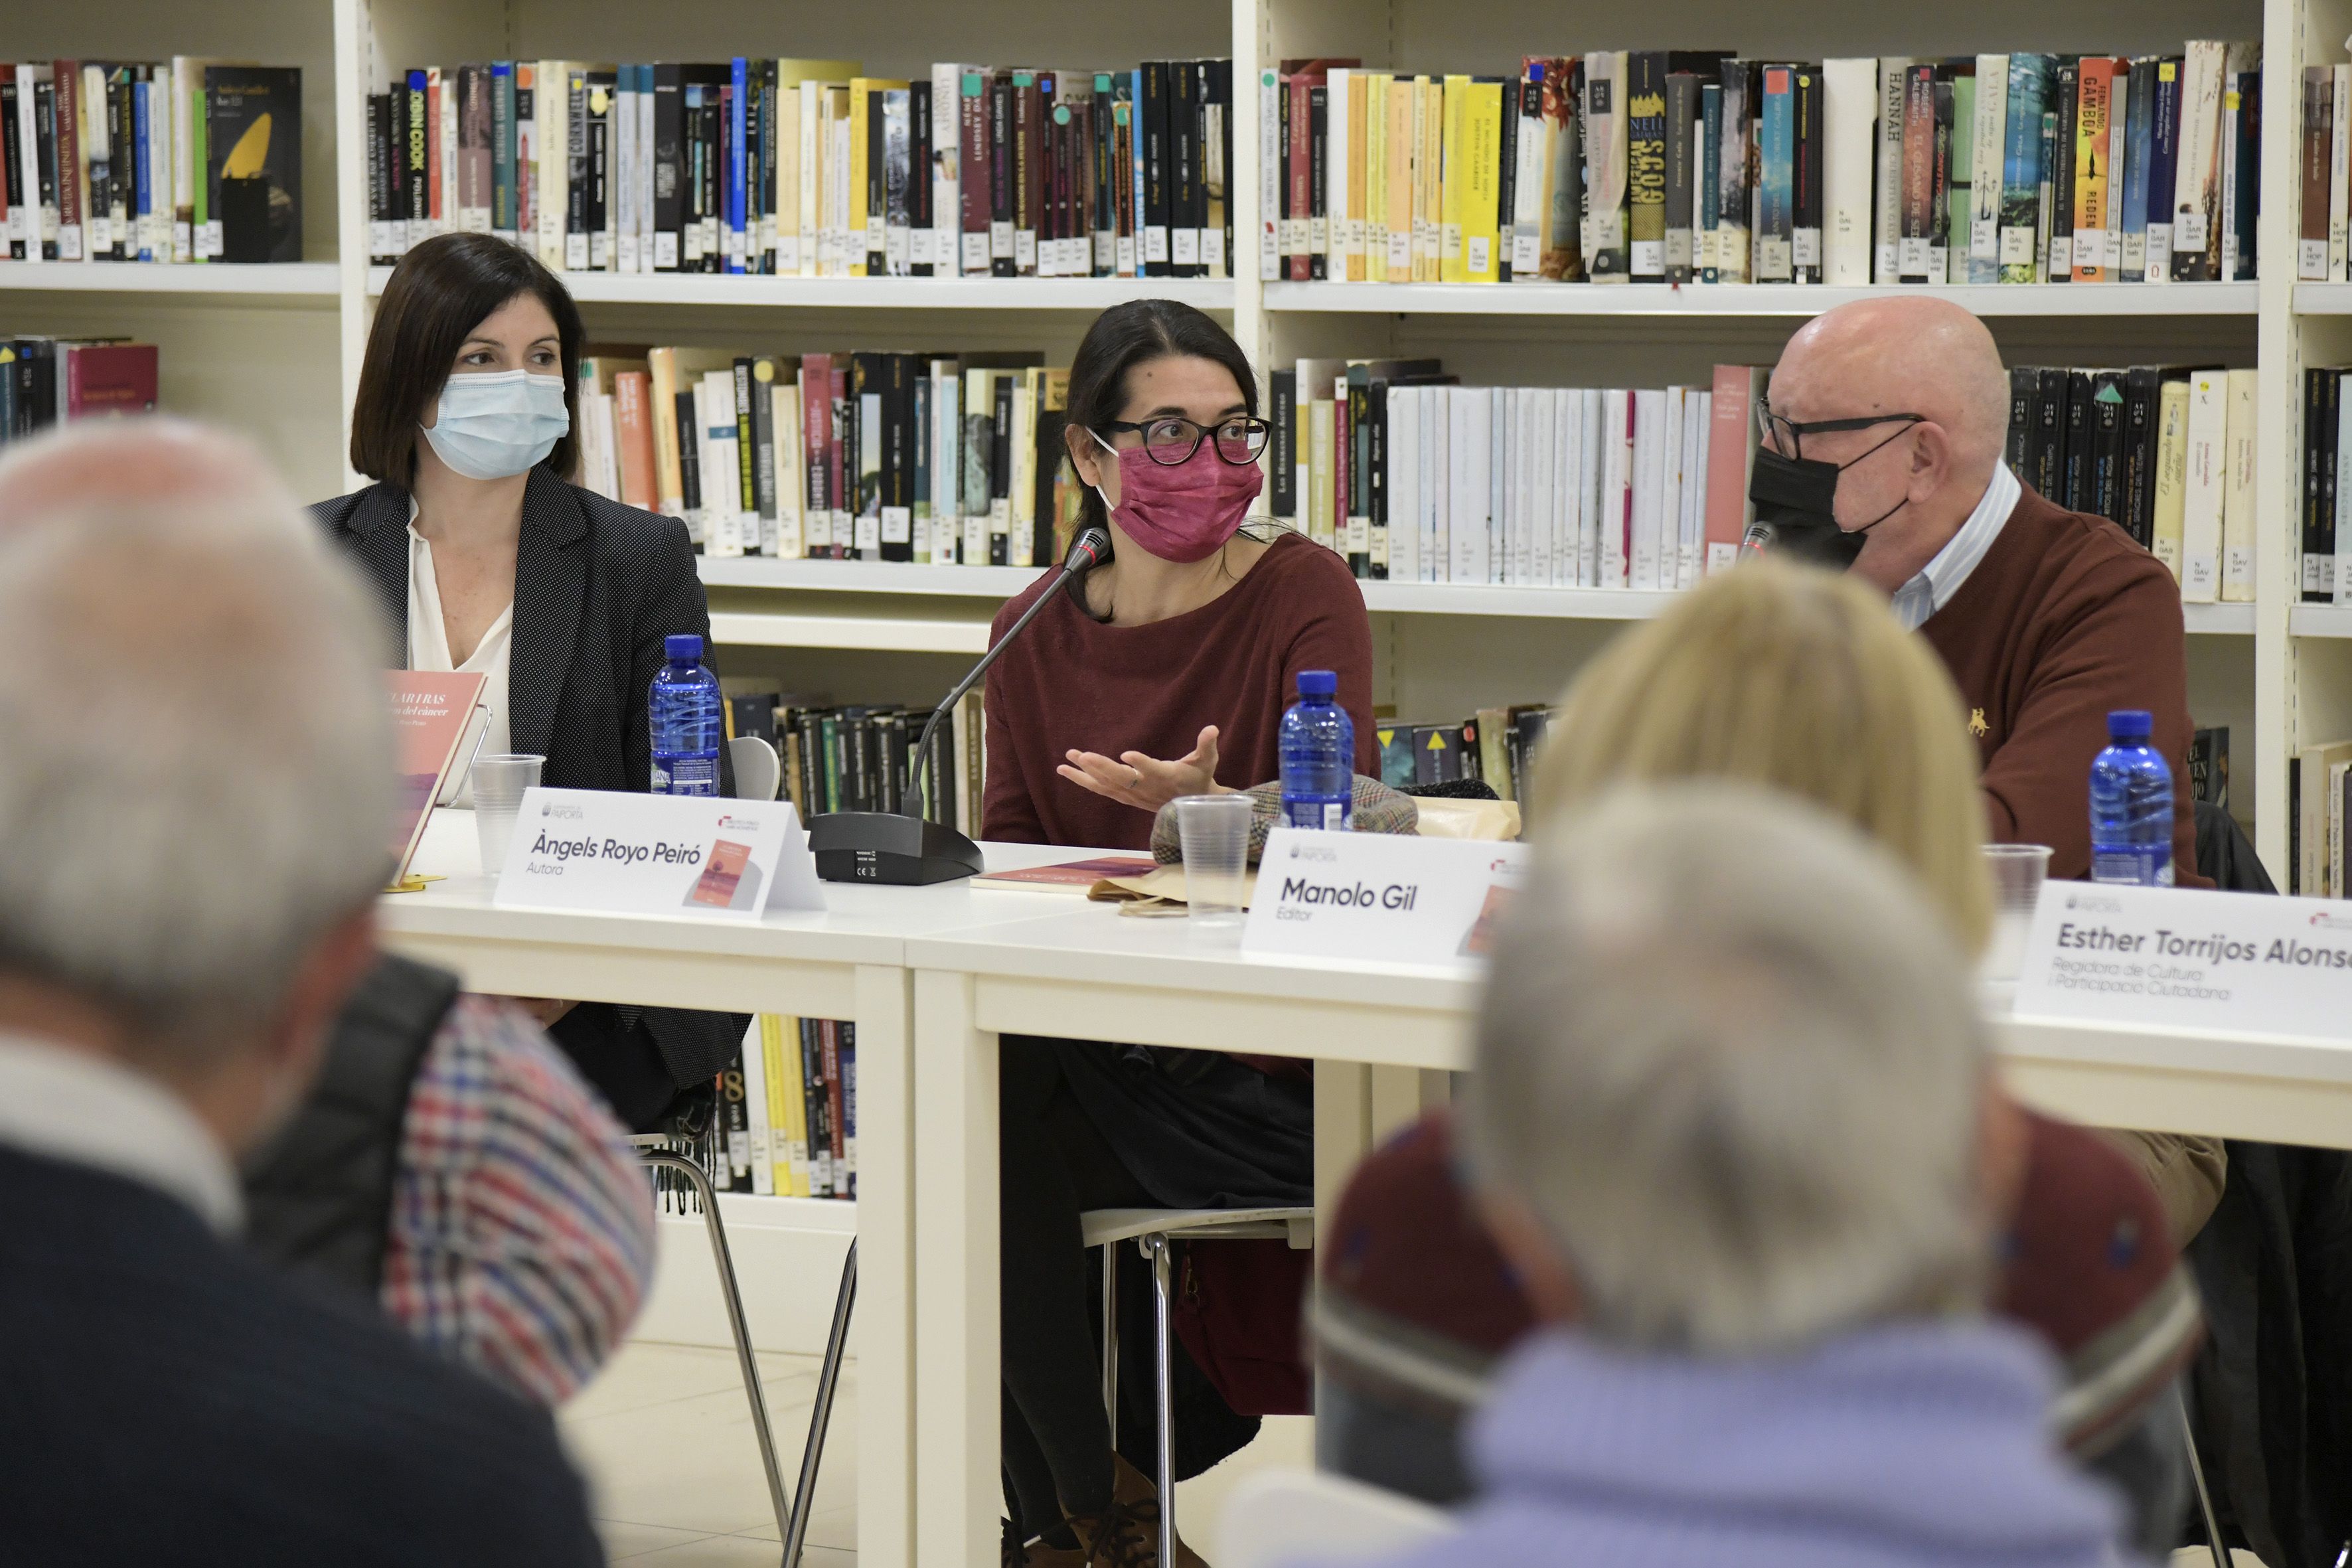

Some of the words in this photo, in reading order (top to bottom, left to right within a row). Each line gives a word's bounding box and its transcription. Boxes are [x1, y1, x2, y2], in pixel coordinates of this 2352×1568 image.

[410, 90, 424, 128] OBIN
[1888, 72, 1903, 142] HANNAH
[1912, 73, 1921, 127] GALBRAITH
[1921, 81, 1930, 118] ROBERT
[2083, 77, 2097, 137] GAMBOA
[2096, 86, 2106, 129] FERNANDO
[973, 116, 982, 161] LINDSEY
[1630, 117, 1664, 131] NEIL
[1915, 134, 1924, 147] EL
[410, 129, 424, 171] COOK
[1640, 139, 1666, 204] GODS
[1912, 150, 1923, 199] GUSANO
[1911, 200, 1921, 218] DE
[2133, 488, 2142, 523] SEÑORES
[387, 693, 415, 704] LAR
[422, 694, 446, 705] RAS
[402, 706, 418, 716] del
[418, 706, 449, 716] càncer
[550, 809, 584, 819] PAIPORTA
[531, 828, 598, 861] Àngels
[601, 838, 649, 866] Royo
[653, 841, 701, 865] Peiró
[526, 862, 564, 876] Autora
[1281, 877, 1375, 907] Manolo
[1383, 884, 1417, 911] Gil
[1276, 906, 1313, 922] Editor
[2057, 922, 2146, 953] Esther
[2155, 929, 2257, 965] Torrijos
[2052, 957, 2120, 977] Regidora
[2124, 963, 2144, 977] de
[2147, 963, 2203, 982] Cultura
[2055, 974, 2144, 994] Participació
[2147, 979, 2231, 1001] Ciutadana
